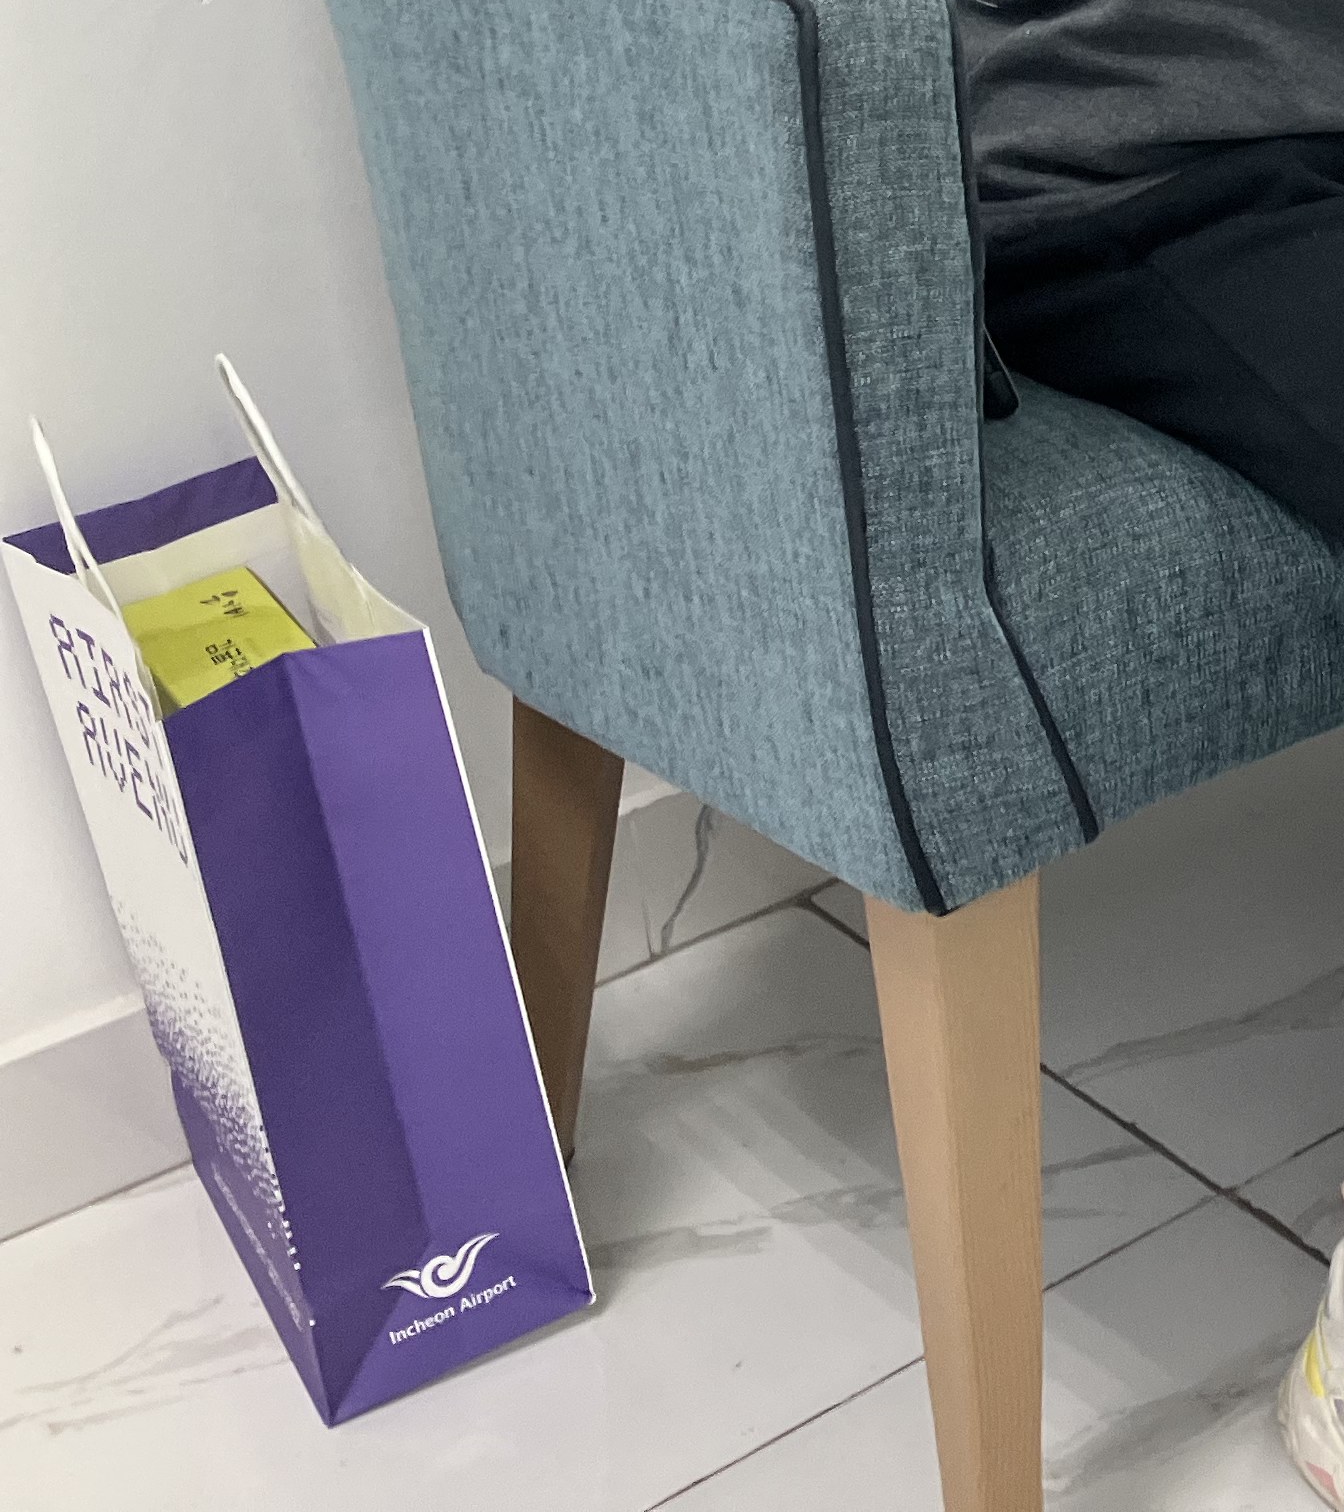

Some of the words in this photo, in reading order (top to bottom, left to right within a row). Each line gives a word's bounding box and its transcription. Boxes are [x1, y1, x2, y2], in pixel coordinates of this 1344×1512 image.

[50, 613, 164, 770] AIRST
[76, 700, 189, 869] AVENU
[388, 1305, 456, 1345] Incheon
[459, 1275, 517, 1314] Airport
